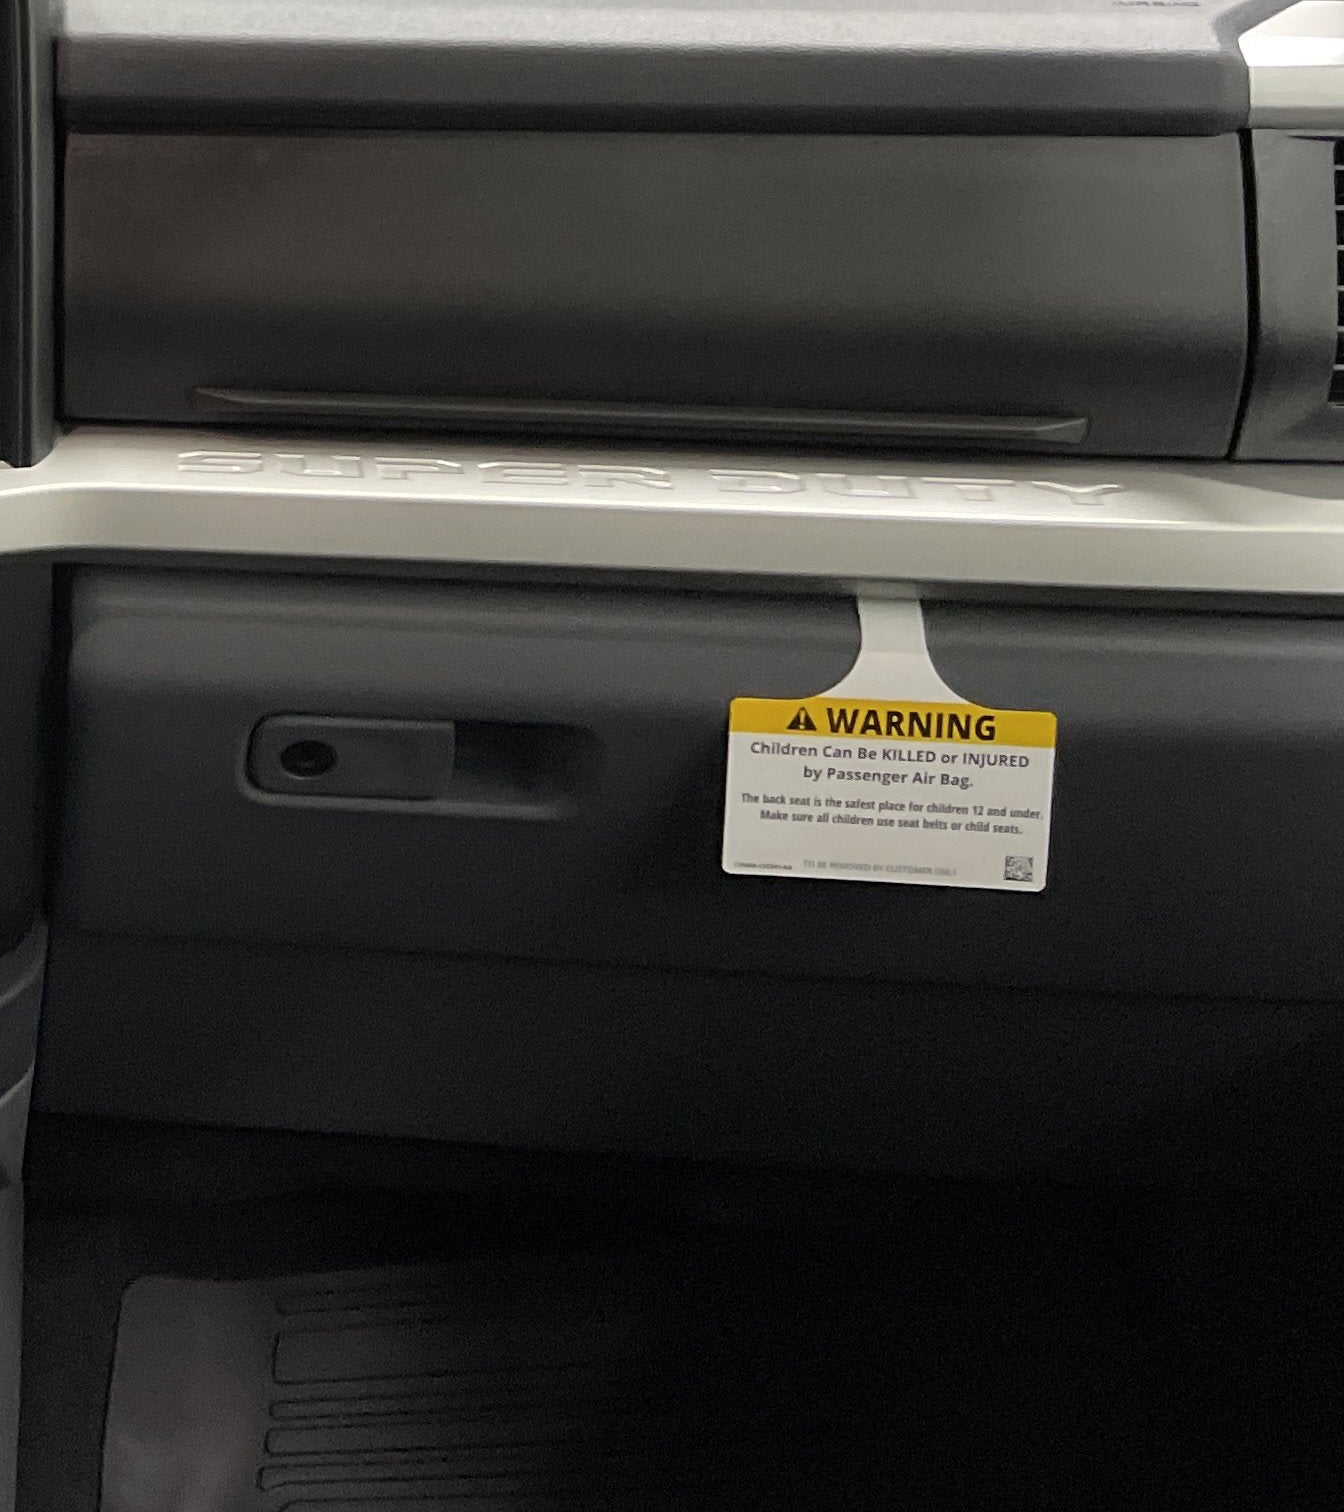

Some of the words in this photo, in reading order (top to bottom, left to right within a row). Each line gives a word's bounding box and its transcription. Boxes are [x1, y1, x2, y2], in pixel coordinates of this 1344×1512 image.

[178, 451, 674, 491] SUPER
[709, 468, 1120, 506] DUTY
[826, 707, 996, 741] WARNING
[750, 741, 818, 757] Children
[823, 745, 852, 759] Can
[857, 747, 877, 761] Be
[882, 748, 936, 763] KILLED
[941, 753, 958, 764] or
[962, 752, 1030, 768] INJURED
[803, 765, 822, 782] by
[827, 767, 908, 786] Passenger
[912, 771, 936, 785] Air
[940, 773, 973, 790] Bag.
[741, 793, 759, 804] The
[763, 794, 786, 805] back
[789, 796, 811, 807] seat
[813, 796, 822, 807] is
[825, 797, 842, 808] the
[844, 797, 875, 811] safest
[878, 799, 906, 813] place
[908, 801, 924, 813] for
[926, 802, 968, 815] children
[972, 805, 984, 816] 12
[987, 806, 1007, 817] and
[1009, 808, 1045, 821] under.
[760, 810, 788, 821] Make
[792, 812, 814, 822] sure
[816, 812, 829, 823] all
[831, 813, 874, 825] children
[876, 817, 895, 827] use
[897, 818, 920, 828] seat
[922, 818, 948, 830] belts
[950, 822, 963, 831] or
[965, 821, 990, 833] child
[992, 823, 1024, 835] seats.
